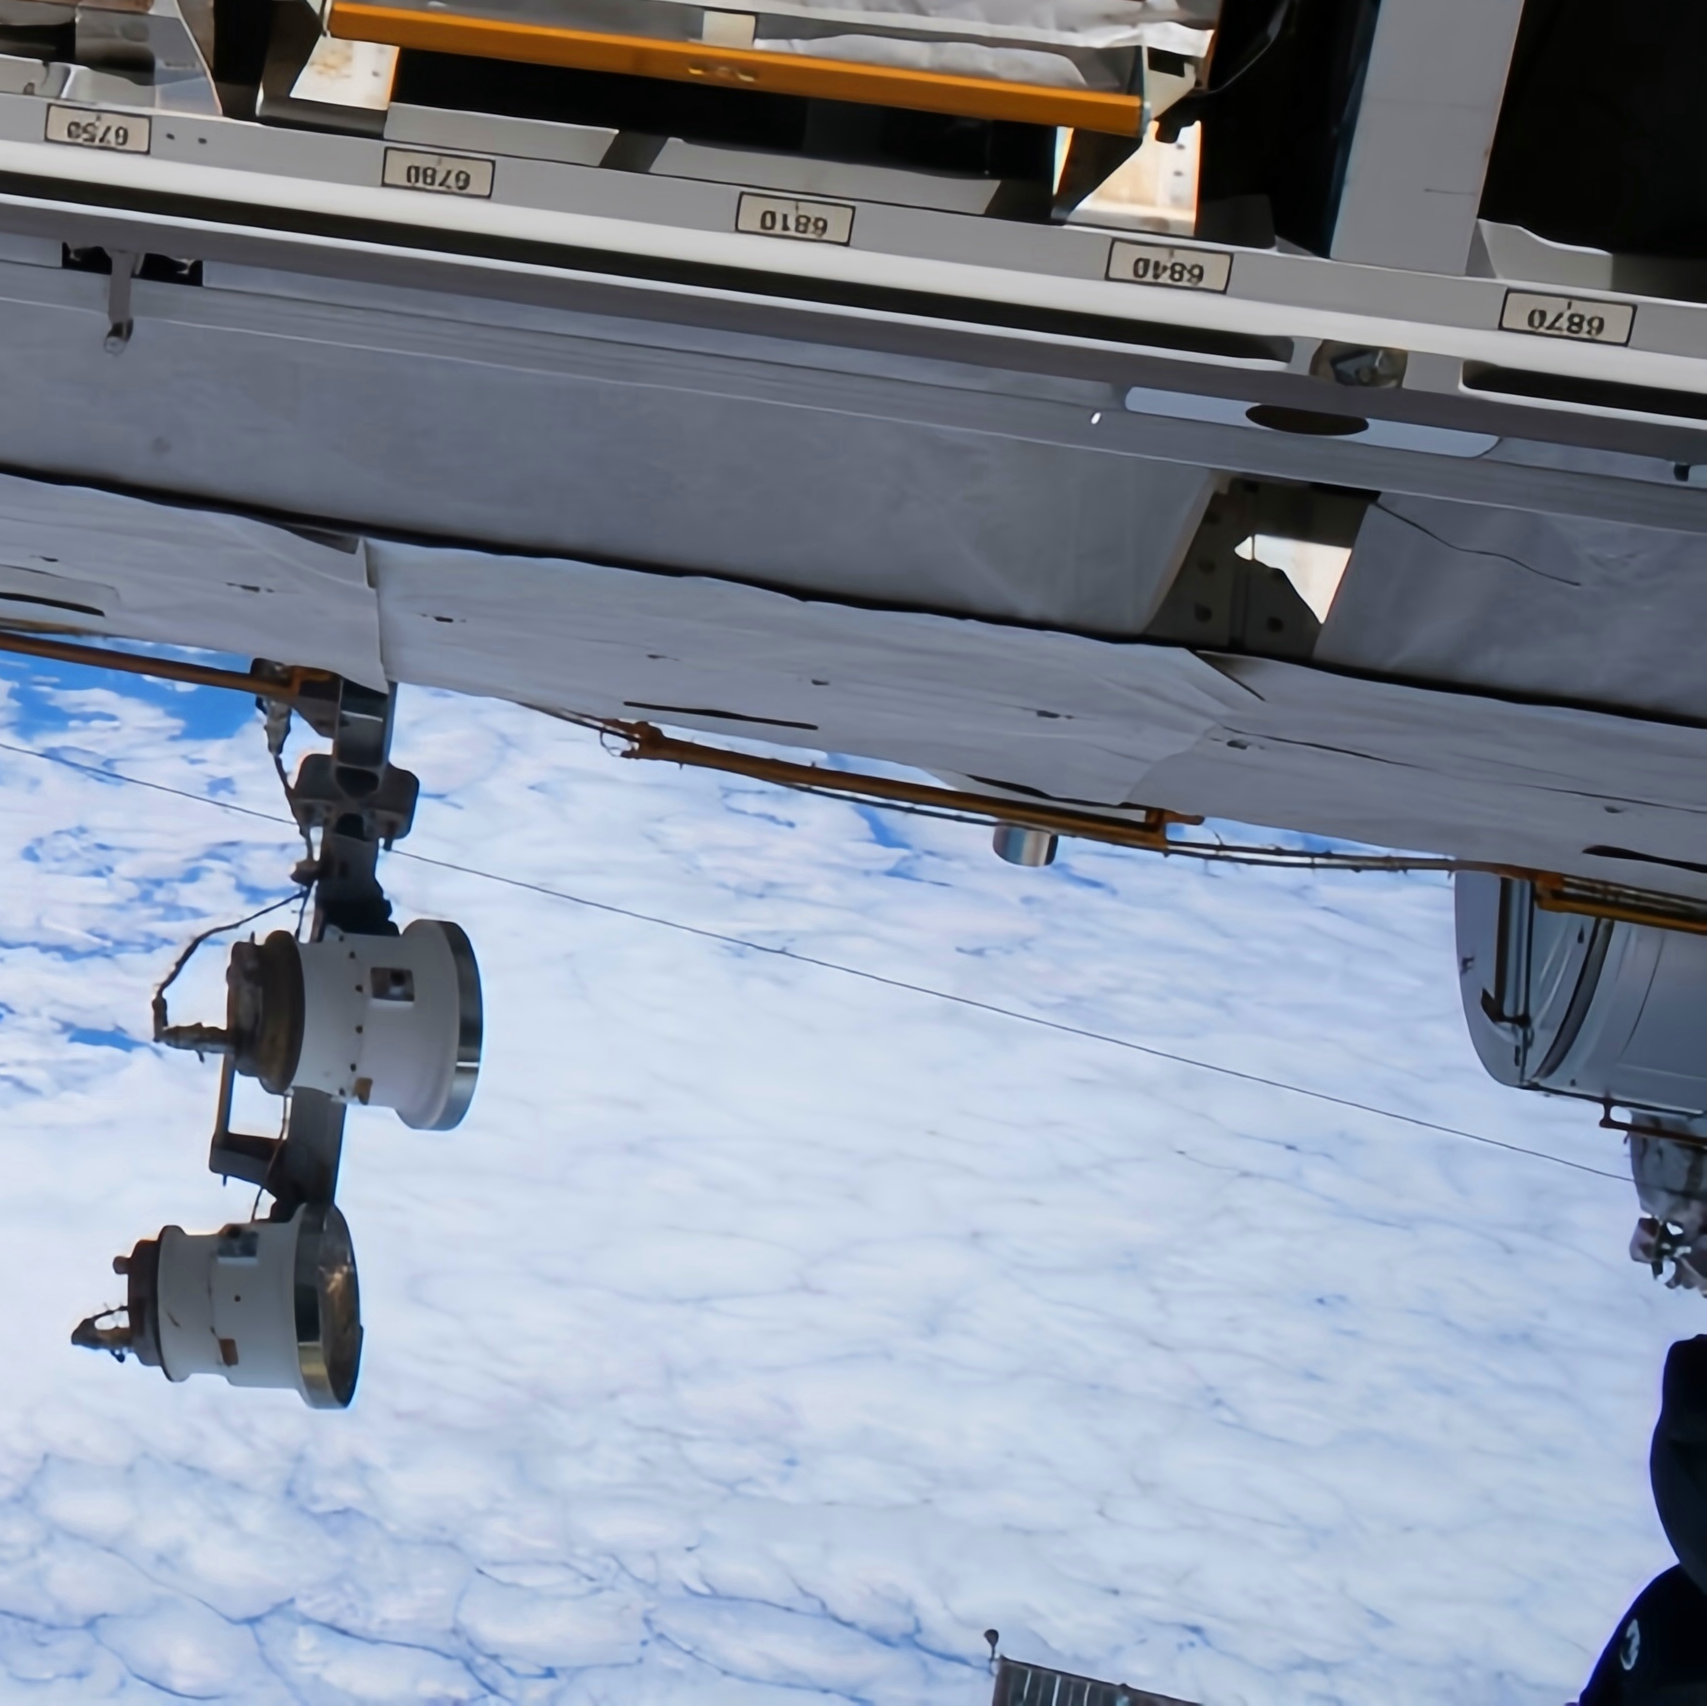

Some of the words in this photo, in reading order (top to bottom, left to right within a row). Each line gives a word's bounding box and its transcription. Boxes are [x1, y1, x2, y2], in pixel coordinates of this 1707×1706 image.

[406, 165, 471, 191] 6780
[759, 210, 828, 237] 6810
[1132, 257, 1205, 285] 6840
[1527, 308, 1605, 337] 6870
